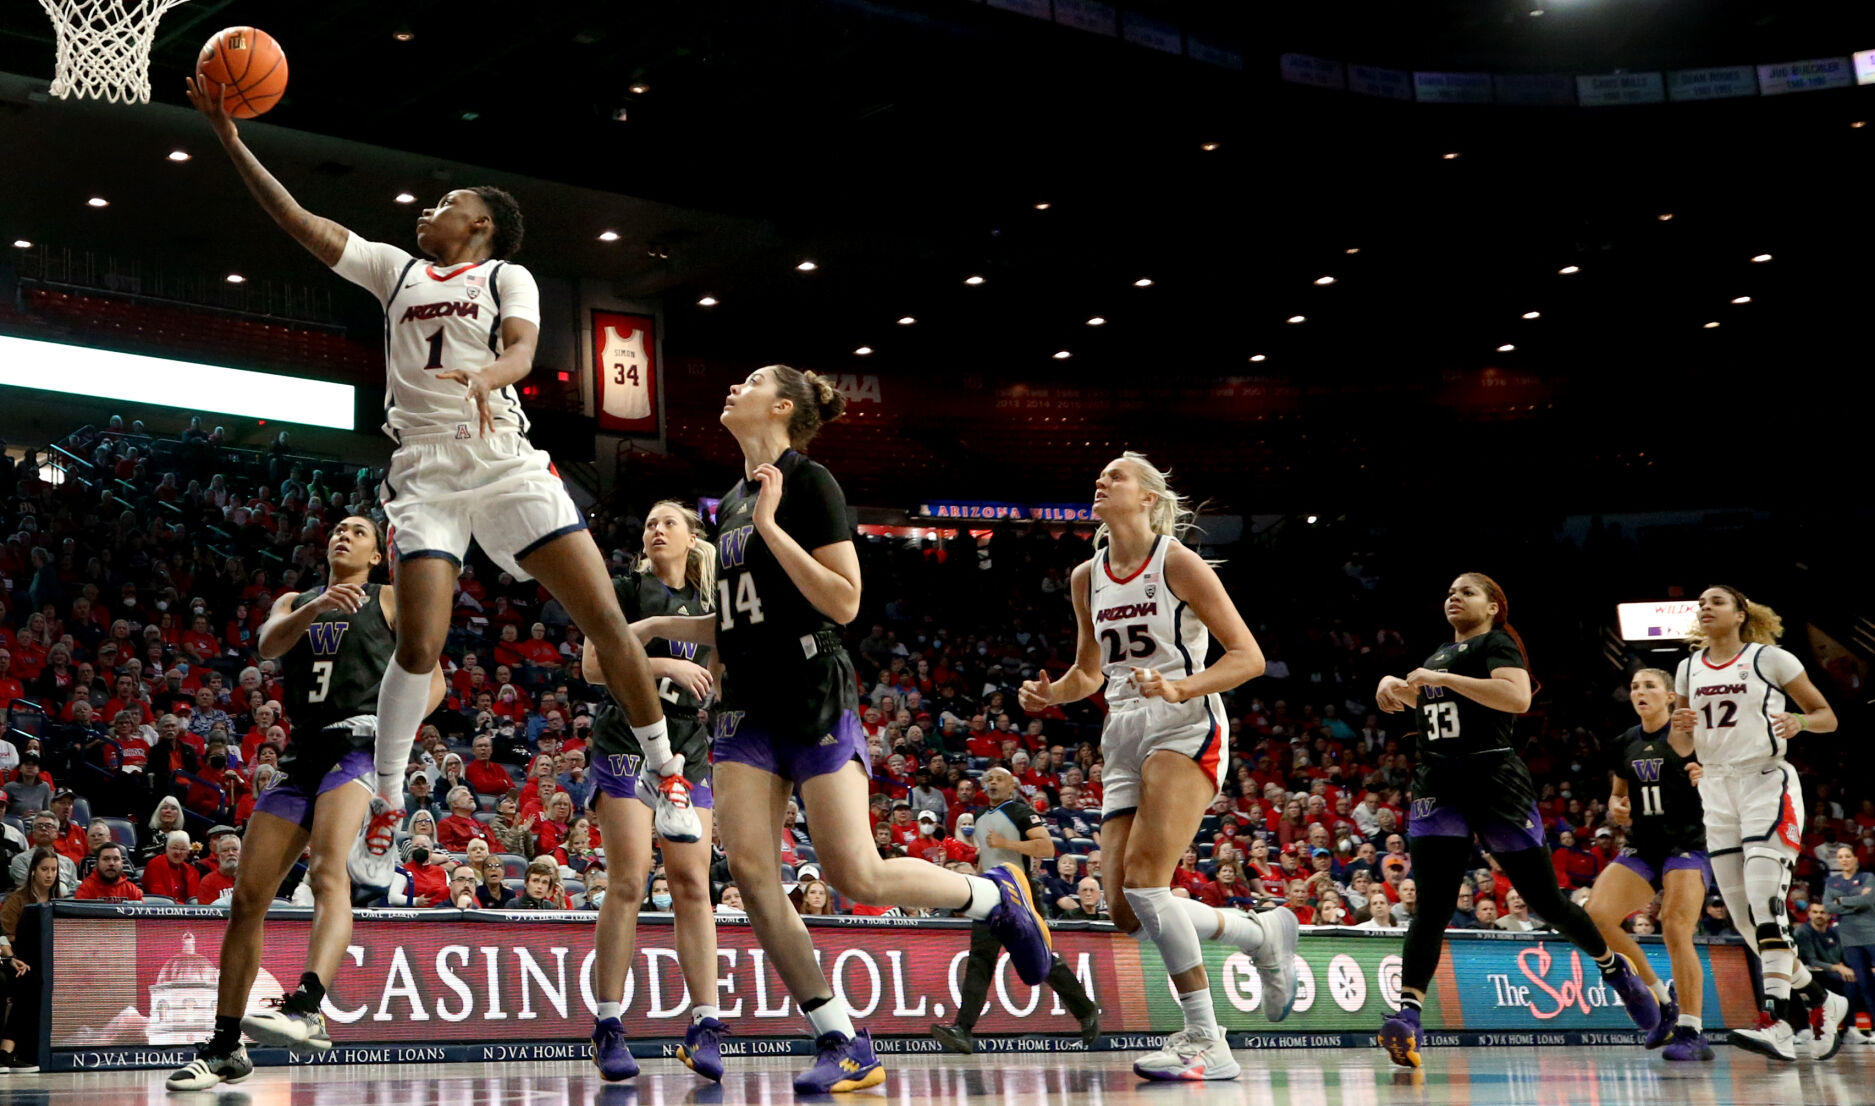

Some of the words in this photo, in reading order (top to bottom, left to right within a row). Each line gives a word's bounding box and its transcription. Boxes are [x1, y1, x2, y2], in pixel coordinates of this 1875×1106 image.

[399, 301, 480, 325] ARIZONA
[424, 325, 445, 371] 1
[614, 348, 636, 359] SIMON
[613, 362, 640, 387] 34
[937, 505, 1022, 520] ARIZONA
[719, 524, 755, 571] W
[717, 571, 765, 631] 14
[1095, 602, 1158, 624] ARIZONA
[306, 621, 350, 656] W
[1101, 624, 1157, 664] 25
[308, 660, 335, 704] 3
[1693, 683, 1748, 700] ARIZONA
[716, 709, 746, 739] W
[1423, 701, 1461, 742] 33
[1700, 700, 1740, 730] 12
[608, 753, 641, 777] W
[1631, 757, 1665, 783] W
[1412, 796, 1437, 819] W
[1640, 785, 1665, 816] 11
[1486, 973, 1532, 1007] The
[1516, 940, 1592, 1020] Sol
[1587, 975, 1609, 1007] of
[719, 1042, 747, 1055] OME
[752, 1041, 792, 1054] LOANS
[906, 1039, 943, 1052] LOANS
[978, 1039, 1014, 1051] NOVA
[1018, 1038, 1050, 1051] HOME
[1279, 1036, 1307, 1048] HOME
[1311, 1035, 1342, 1047] LOANS
[1431, 1035, 1460, 1046] LOANS
[1478, 1035, 1507, 1047] NOVA
[1508, 1034, 1535, 1046] HOME
[1537, 1034, 1566, 1045] LOANS
[1581, 1034, 1609, 1045] NOVA
[1611, 1033, 1636, 1044] HOME
[73, 1051, 128, 1068] NOVA
[135, 1051, 184, 1066] HOME
[345, 1049, 391, 1063] HOME
[398, 1047, 446, 1062] LOANS
[483, 1046, 529, 1060] NOVA
[533, 1045, 575, 1059] HOME
